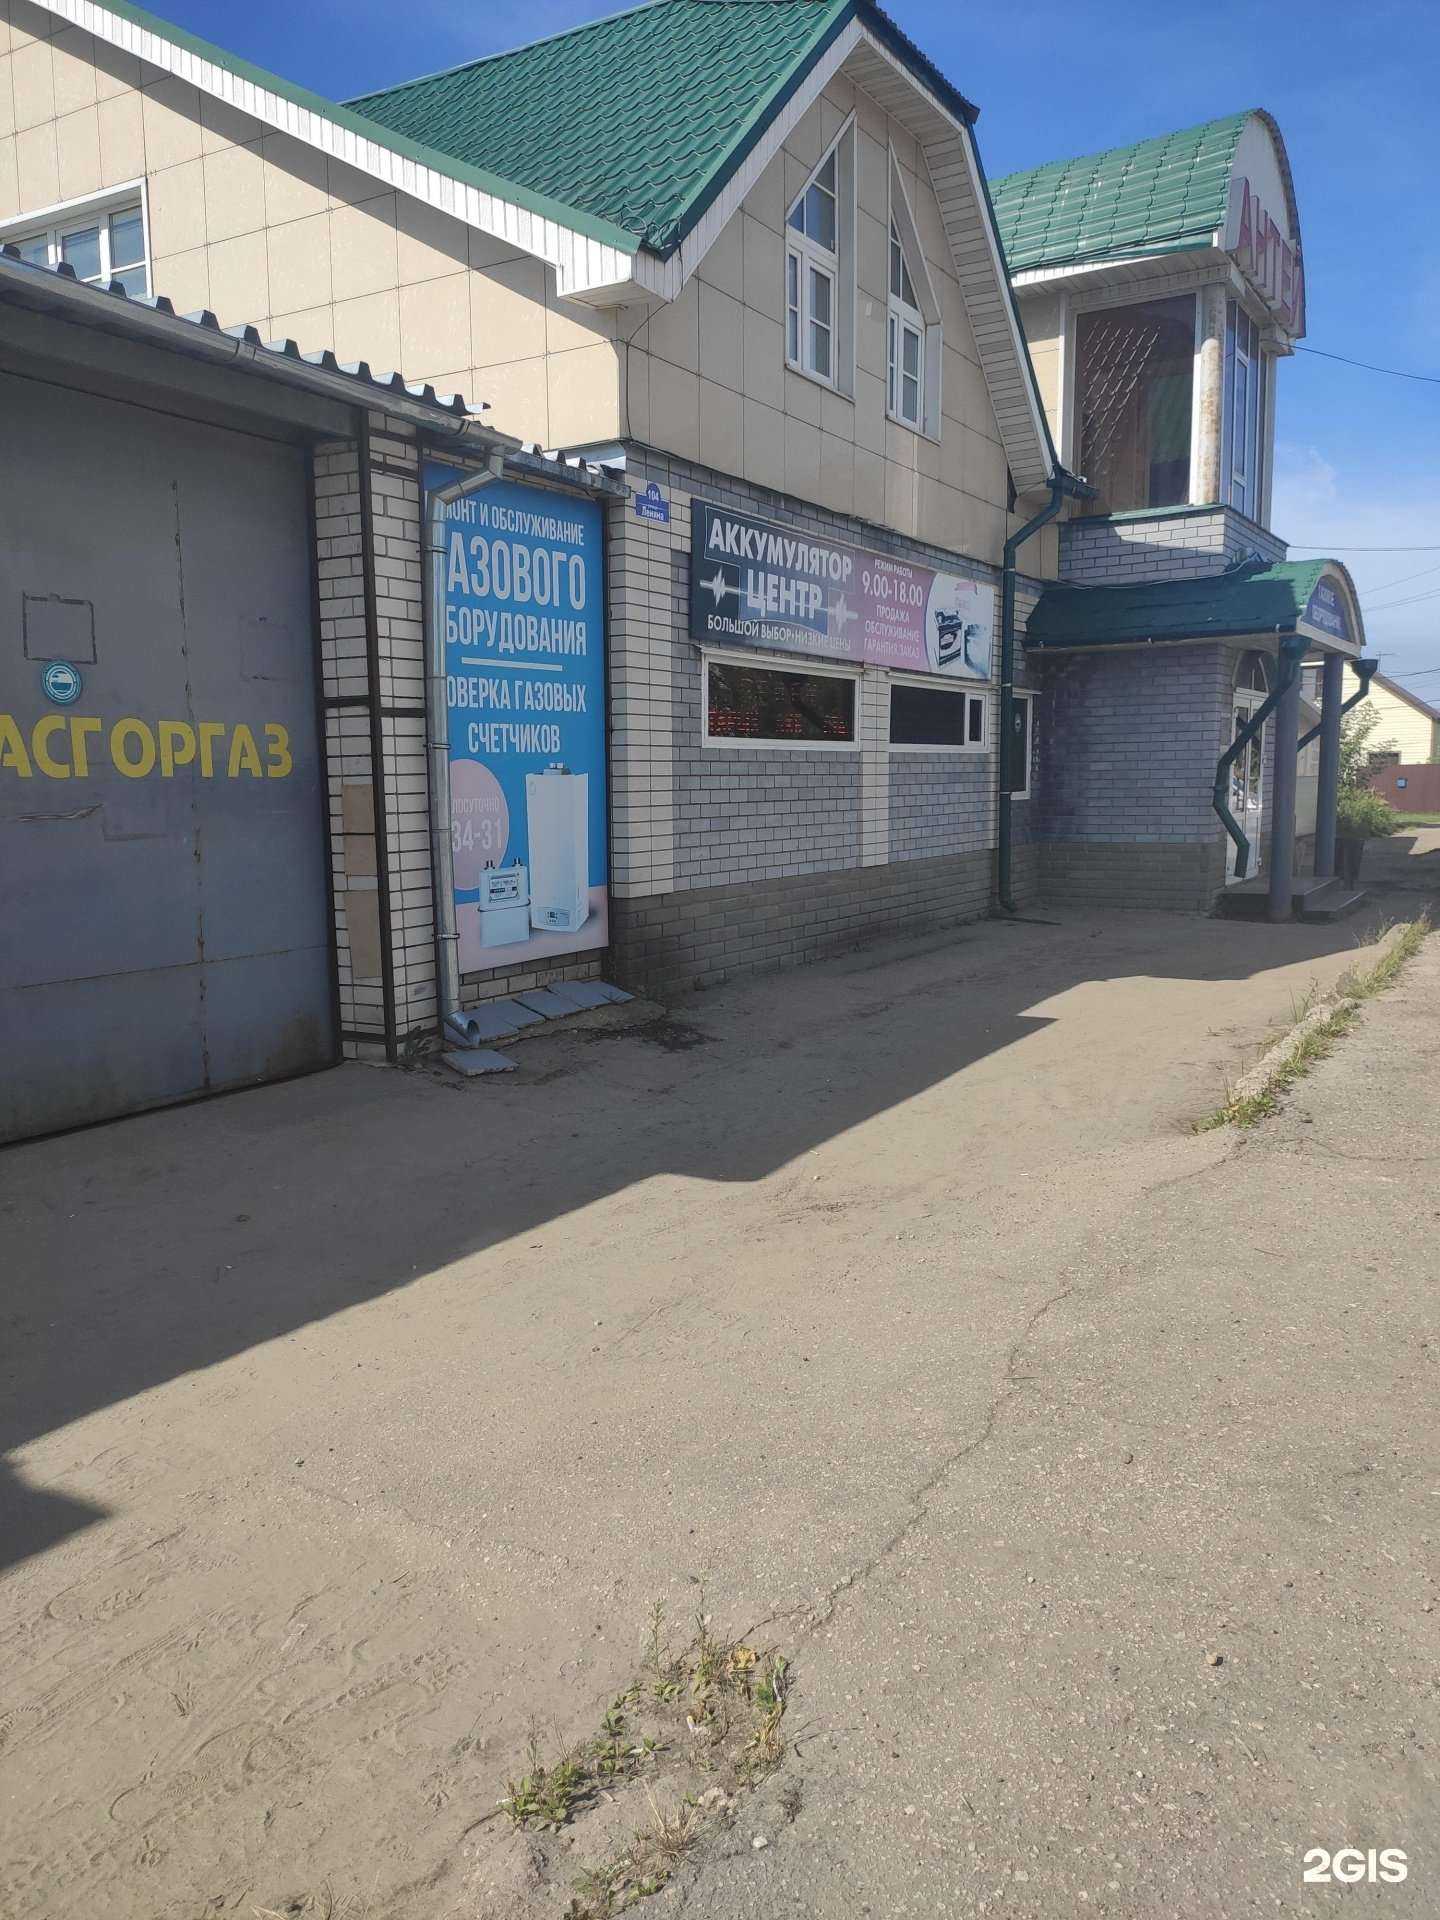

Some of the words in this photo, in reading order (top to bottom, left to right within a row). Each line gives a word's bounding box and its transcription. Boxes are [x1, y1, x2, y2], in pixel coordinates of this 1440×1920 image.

[480, 502, 489, 527] И
[491, 506, 585, 546] ОБСЛУЖИВАНИЕ
[447, 532, 586, 610] АЗОВОГО
[709, 518, 852, 584] АККУМУЛЯТОР
[747, 568, 823, 619] ЦЕНТР
[862, 571, 923, 607] 9.00-18.00
[446, 605, 587, 656] БОРУДОВАНИЯ
[707, 614, 760, 638] БОЛЬШОЙ
[876, 604, 910, 625] ПРОДАЖА
[446, 675, 511, 709] ОВЕРКА
[514, 680, 587, 713] ГАЗОВЫХ
[468, 722, 561, 753] СЧЕТЧИКОВ
